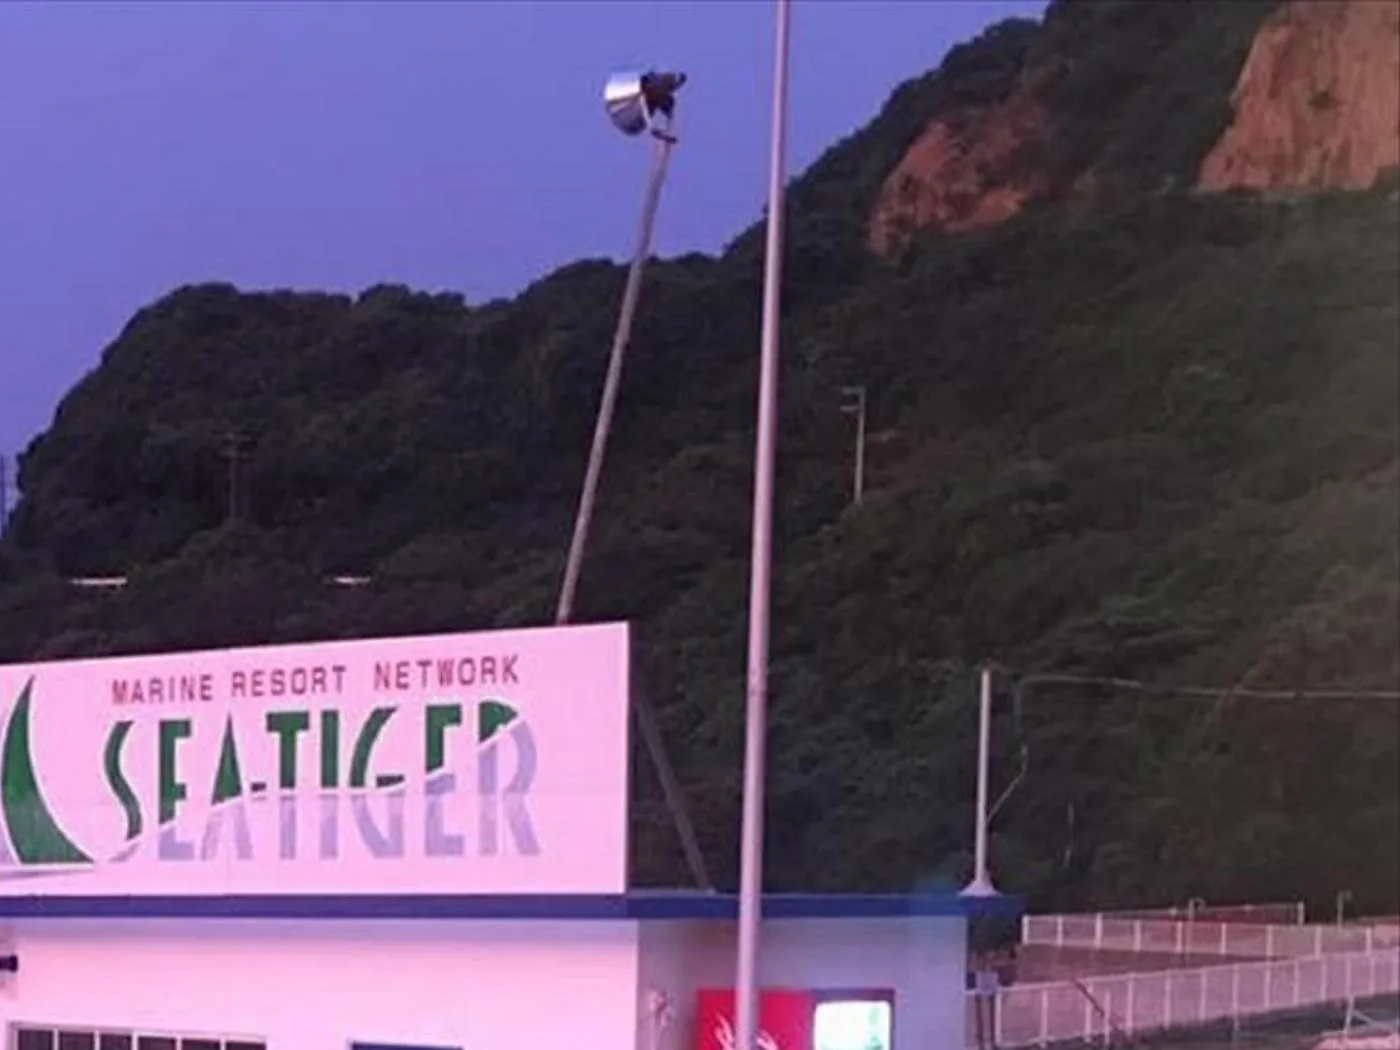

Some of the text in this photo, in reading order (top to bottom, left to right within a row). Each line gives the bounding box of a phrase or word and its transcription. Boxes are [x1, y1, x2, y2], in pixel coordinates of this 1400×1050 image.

[112, 655, 519, 704] MARINE RESORT NETWORK
